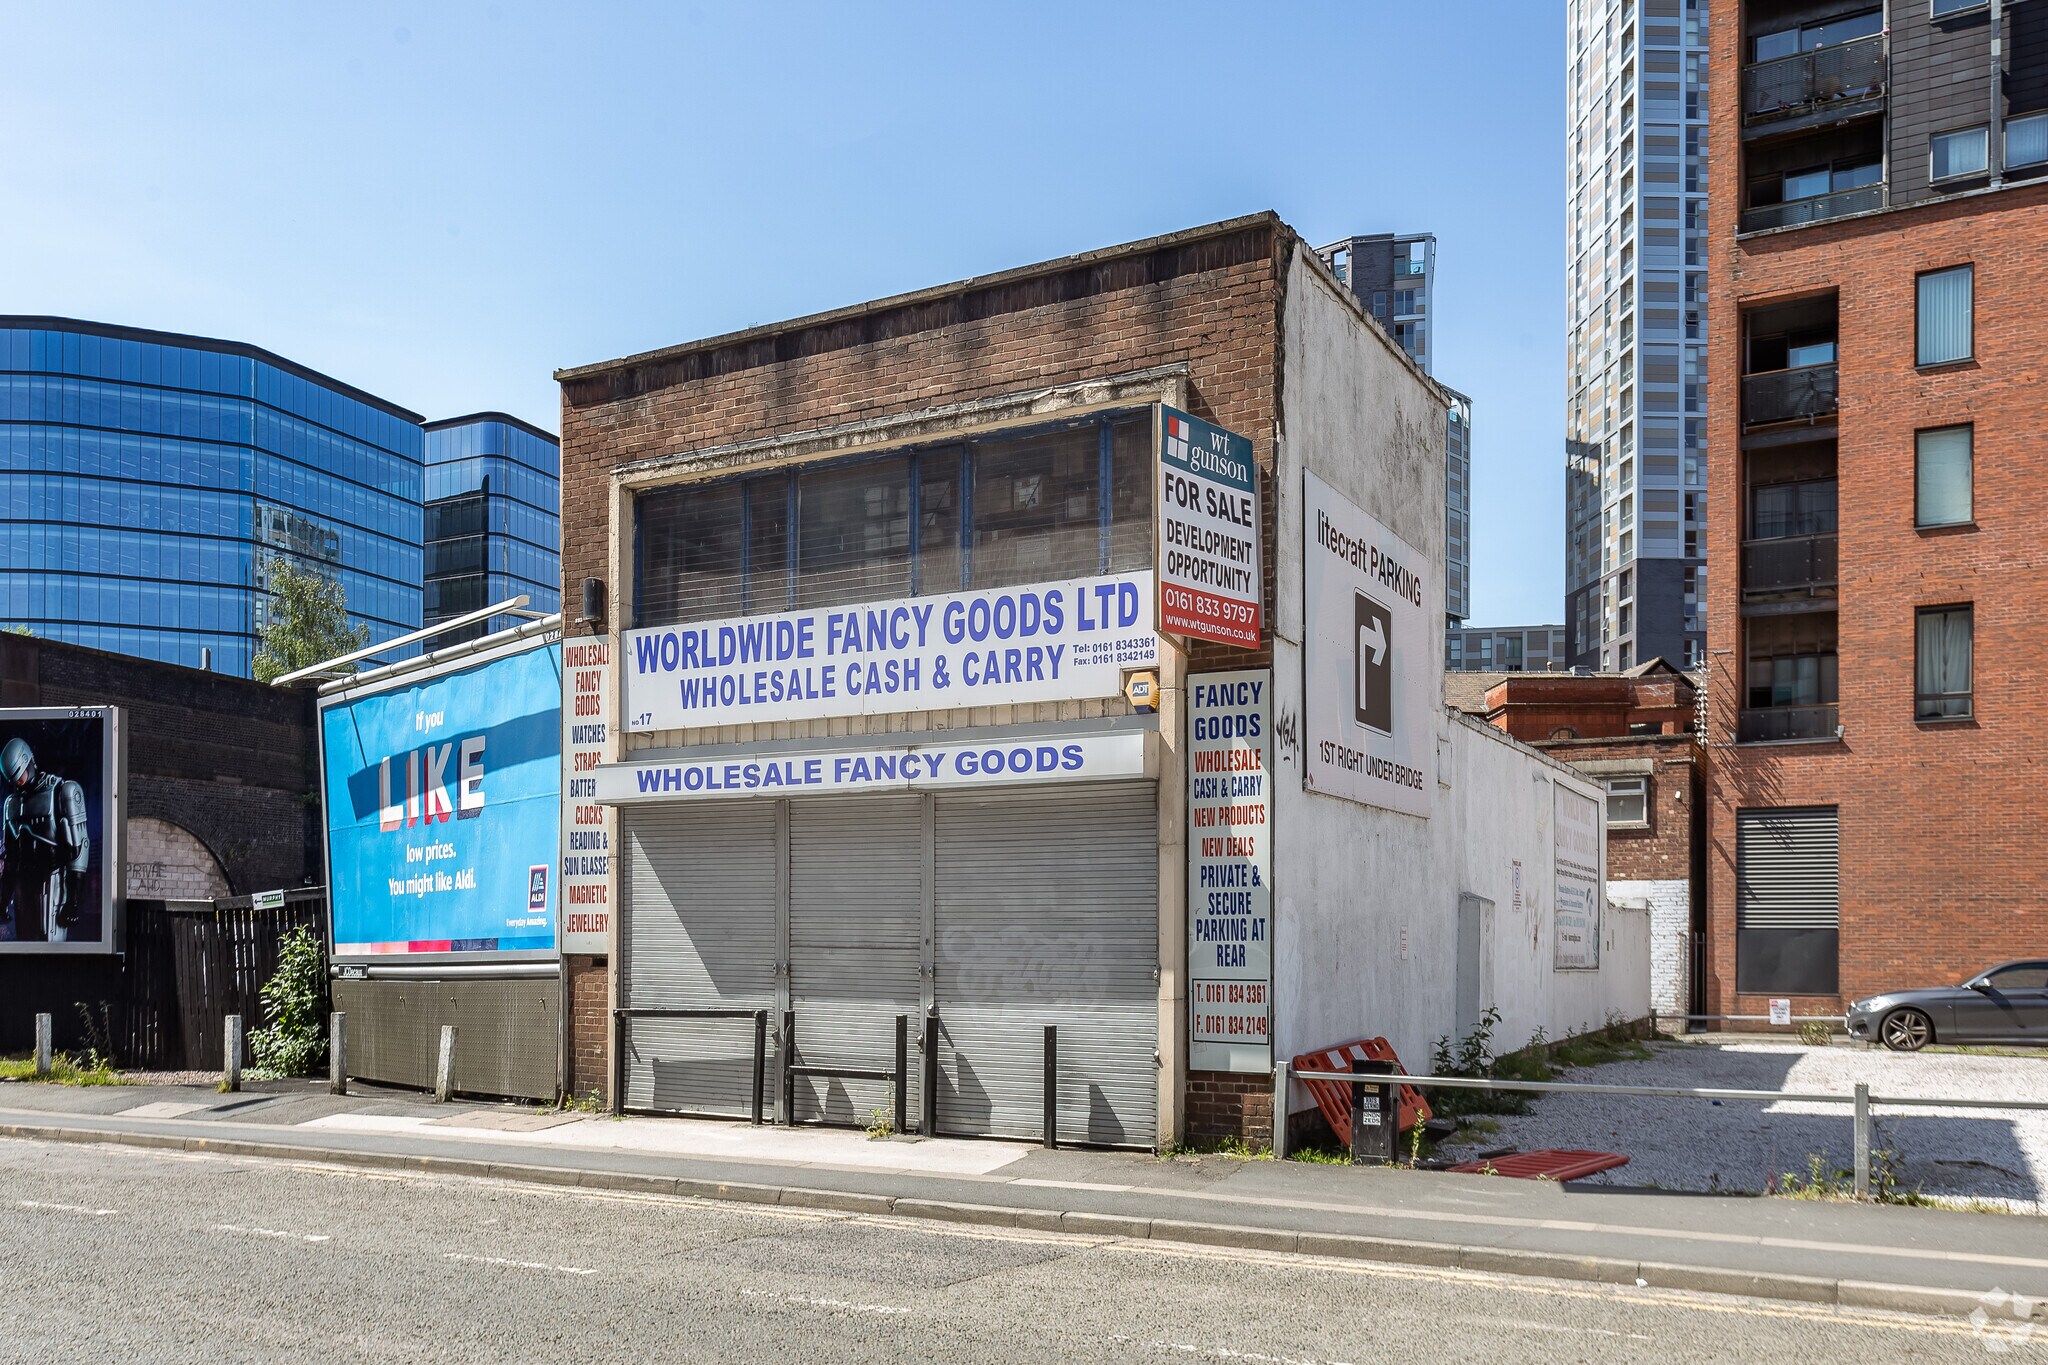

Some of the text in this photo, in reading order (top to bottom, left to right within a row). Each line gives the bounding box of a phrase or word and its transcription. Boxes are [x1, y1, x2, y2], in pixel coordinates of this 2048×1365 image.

[1210, 431, 1230, 456] wt
[1190, 446, 1248, 483] gunson
[1165, 472, 1252, 528] FOR SALE
[1167, 518, 1252, 565] DEVELOPMENT
[1317, 508, 1421, 608] litecraft PARKING
[1167, 550, 1251, 593] OPPORTUNITY
[1165, 588, 1255, 624] 0161 833 9797
[636, 582, 1139, 674] WORLDWIDE FANCY GOODS LTD
[1166, 614, 1257, 642] www.wtgunson.co.uk
[1073, 637, 1155, 653] Tel: 0161 8343361
[1074, 650, 1155, 666] Fax: 0161 8342149
[575, 670, 602, 693] FANCY
[680, 644, 1066, 709] WHOLESALE CASH & CARRY
[1133, 684, 1150, 695] ADT
[1195, 681, 1264, 709] FANCY
[68, 710, 103, 718] 028401
[575, 694, 601, 717] GOODS
[415, 710, 444, 735] If you
[639, 712, 653, 726] 17
[1194, 713, 1261, 741] GOODS
[572, 723, 606, 744] WATCHES
[574, 751, 602, 771] STRAPS
[637, 745, 1085, 793] WHOLESALE FANCY GOODS
[1194, 748, 1261, 773] WHOLESALE
[1319, 739, 1423, 791] 1ST RIGHT UNDER BRIDGE
[380, 736, 486, 828] LIKE
[570, 779, 596, 797] BATTER
[1194, 775, 1263, 799] CASH & CARRY
[575, 805, 603, 825] CLOCKS
[1194, 804, 1265, 828] NEW PRODUCTS
[406, 838, 457, 866] low prices.
[570, 831, 608, 850] READING &
[1202, 836, 1254, 857] NEW DEALS
[565, 856, 579, 875] SUN
[1201, 864, 1261, 888] PRIVATE &
[388, 867, 476, 898] You might like Aldi.
[569, 885, 607, 904] MAGNETIC
[531, 893, 545, 903] ALDI
[1208, 892, 1252, 916] SECURE
[506, 917, 526, 929] Everyday
[567, 913, 609, 933] JEWELLERY
[1196, 918, 1265, 942] PARKING AT
[1217, 944, 1246, 967] REAR
[1197, 983, 1266, 1004] T. 0161 834 3361
[1196, 1015, 1267, 1036] F. 0161 834 2149
